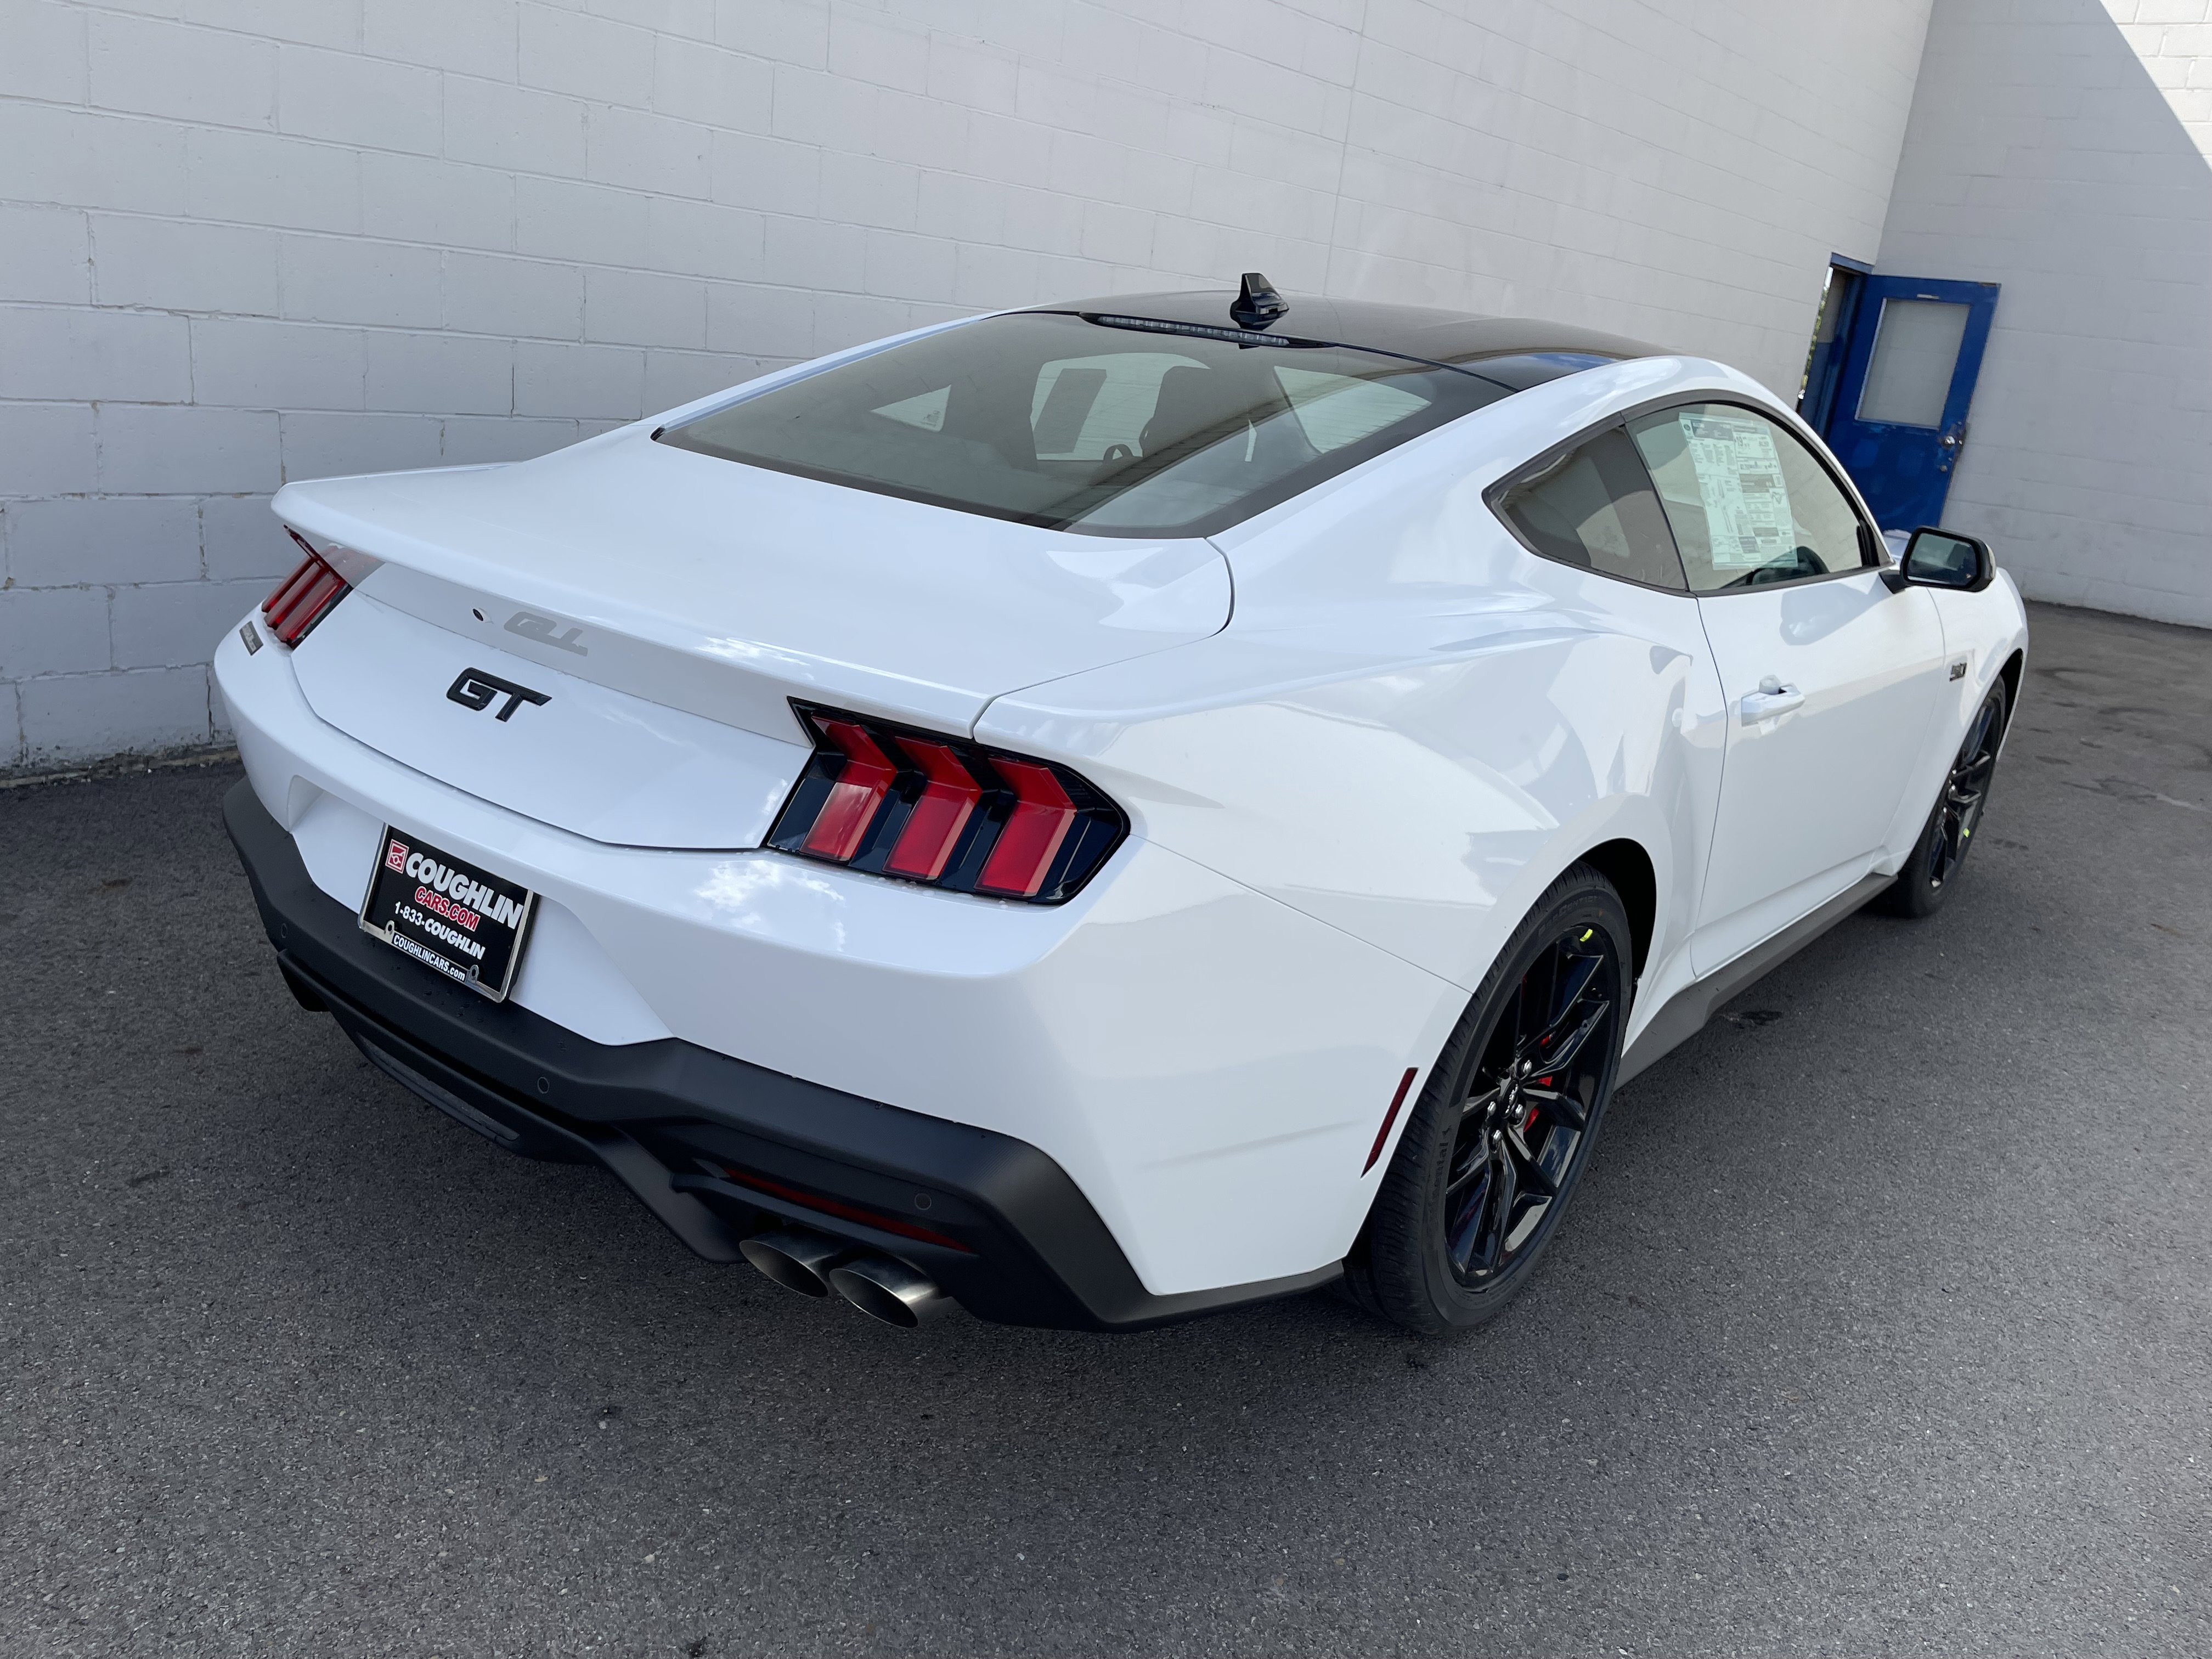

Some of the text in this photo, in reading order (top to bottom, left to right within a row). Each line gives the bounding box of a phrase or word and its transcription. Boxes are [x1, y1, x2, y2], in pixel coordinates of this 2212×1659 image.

[446, 667, 552, 722] GT
[406, 853, 523, 929] COUGHLIN
[415, 886, 481, 932] CARS.COM
[394, 935, 465, 981] COUGHLINCARS.com
[395, 901, 486, 960] 1-833-COUGHLIN
